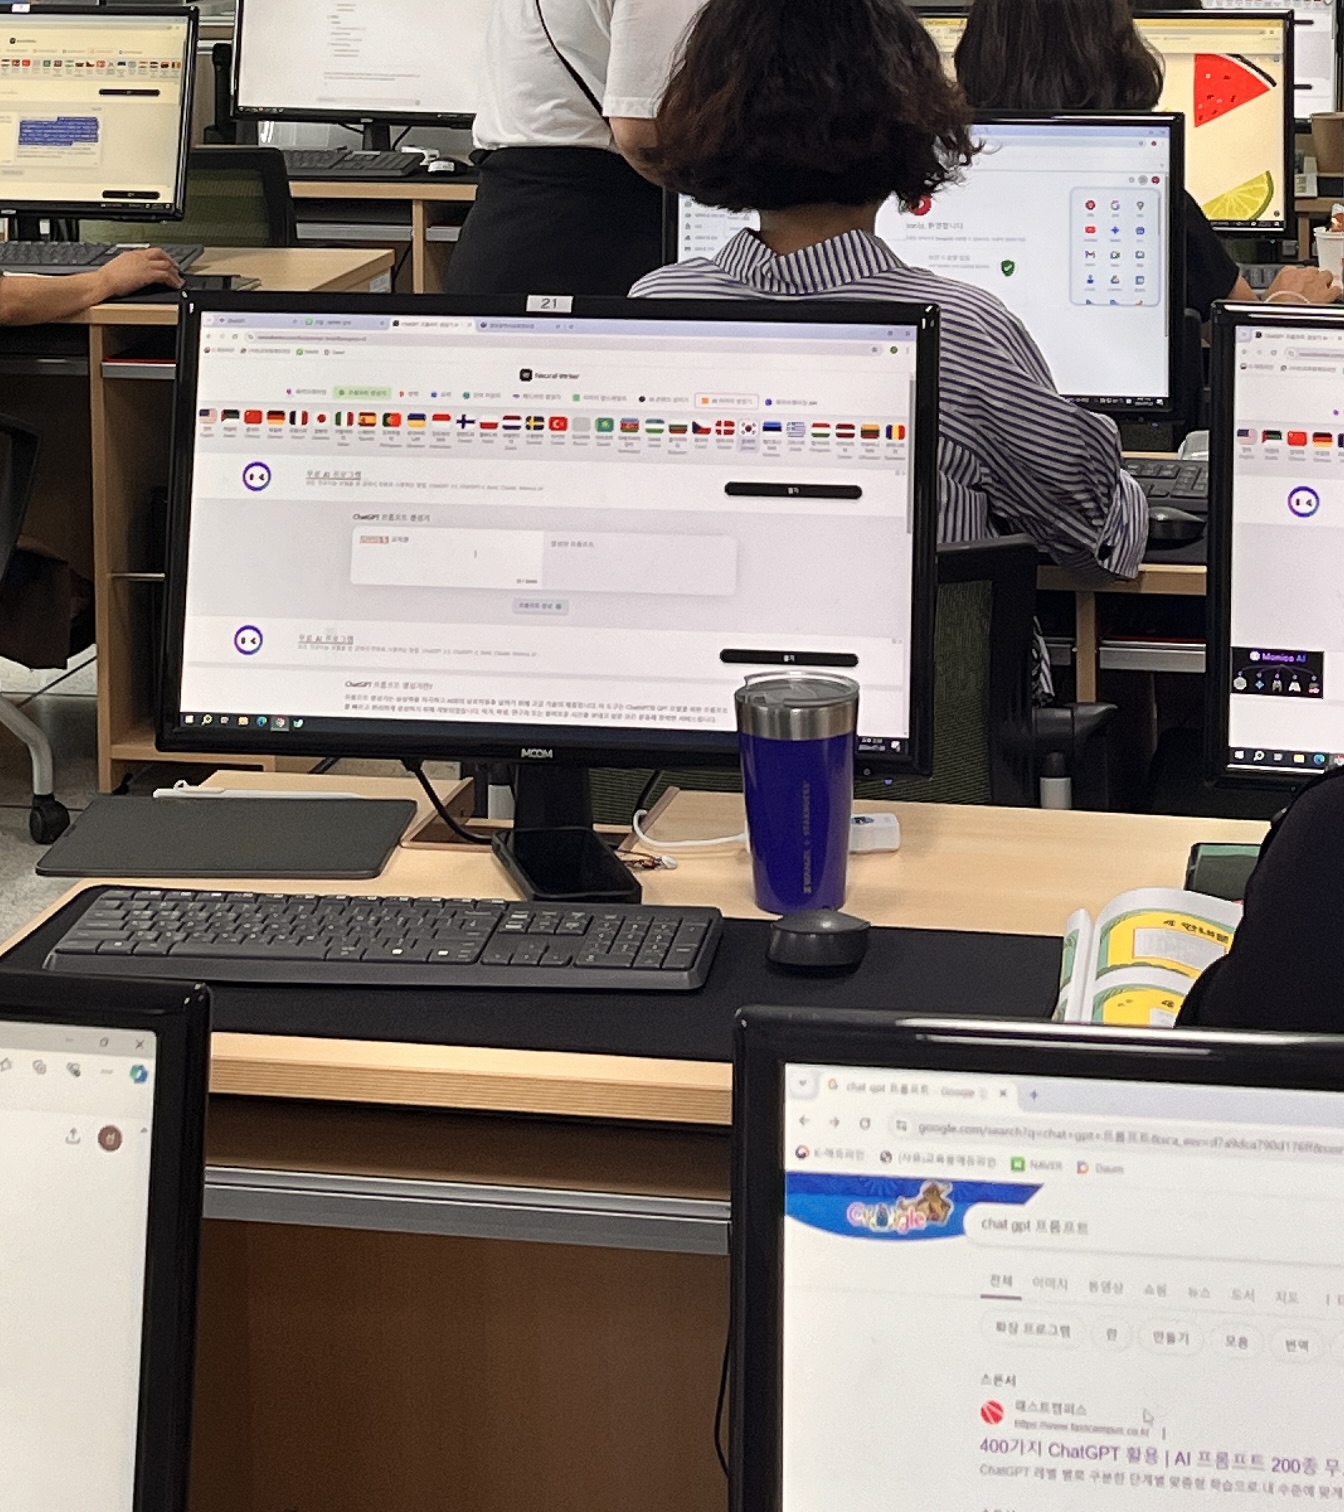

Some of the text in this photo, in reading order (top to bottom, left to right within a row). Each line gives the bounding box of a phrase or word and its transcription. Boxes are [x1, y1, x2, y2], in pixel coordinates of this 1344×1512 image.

[540, 297, 558, 310] 21
[981, 1218, 1089, 1235] chat gpt 프롬프트
[990, 1274, 1013, 1288] 전체
[1032, 1275, 1068, 1291] 이미지
[1187, 1286, 1211, 1299] 뉴스
[1230, 1288, 1256, 1303] 도서
[1275, 1290, 1300, 1305] 지도
[1153, 1331, 1190, 1346] 만들기
[1285, 1339, 1309, 1353] 번역
[980, 1374, 1017, 1387] 스폰서
[980, 1438, 1042, 1456] 400가지
[1048, 1442, 1121, 1462] ChatGPT
[1127, 1446, 1159, 1465] 활용
[1174, 1451, 1191, 1467] AI
[1197, 1451, 1265, 1471] 프롬프트
[1271, 1457, 1318, 1476] 200종
[979, 1464, 1030, 1478] ChatGPT
